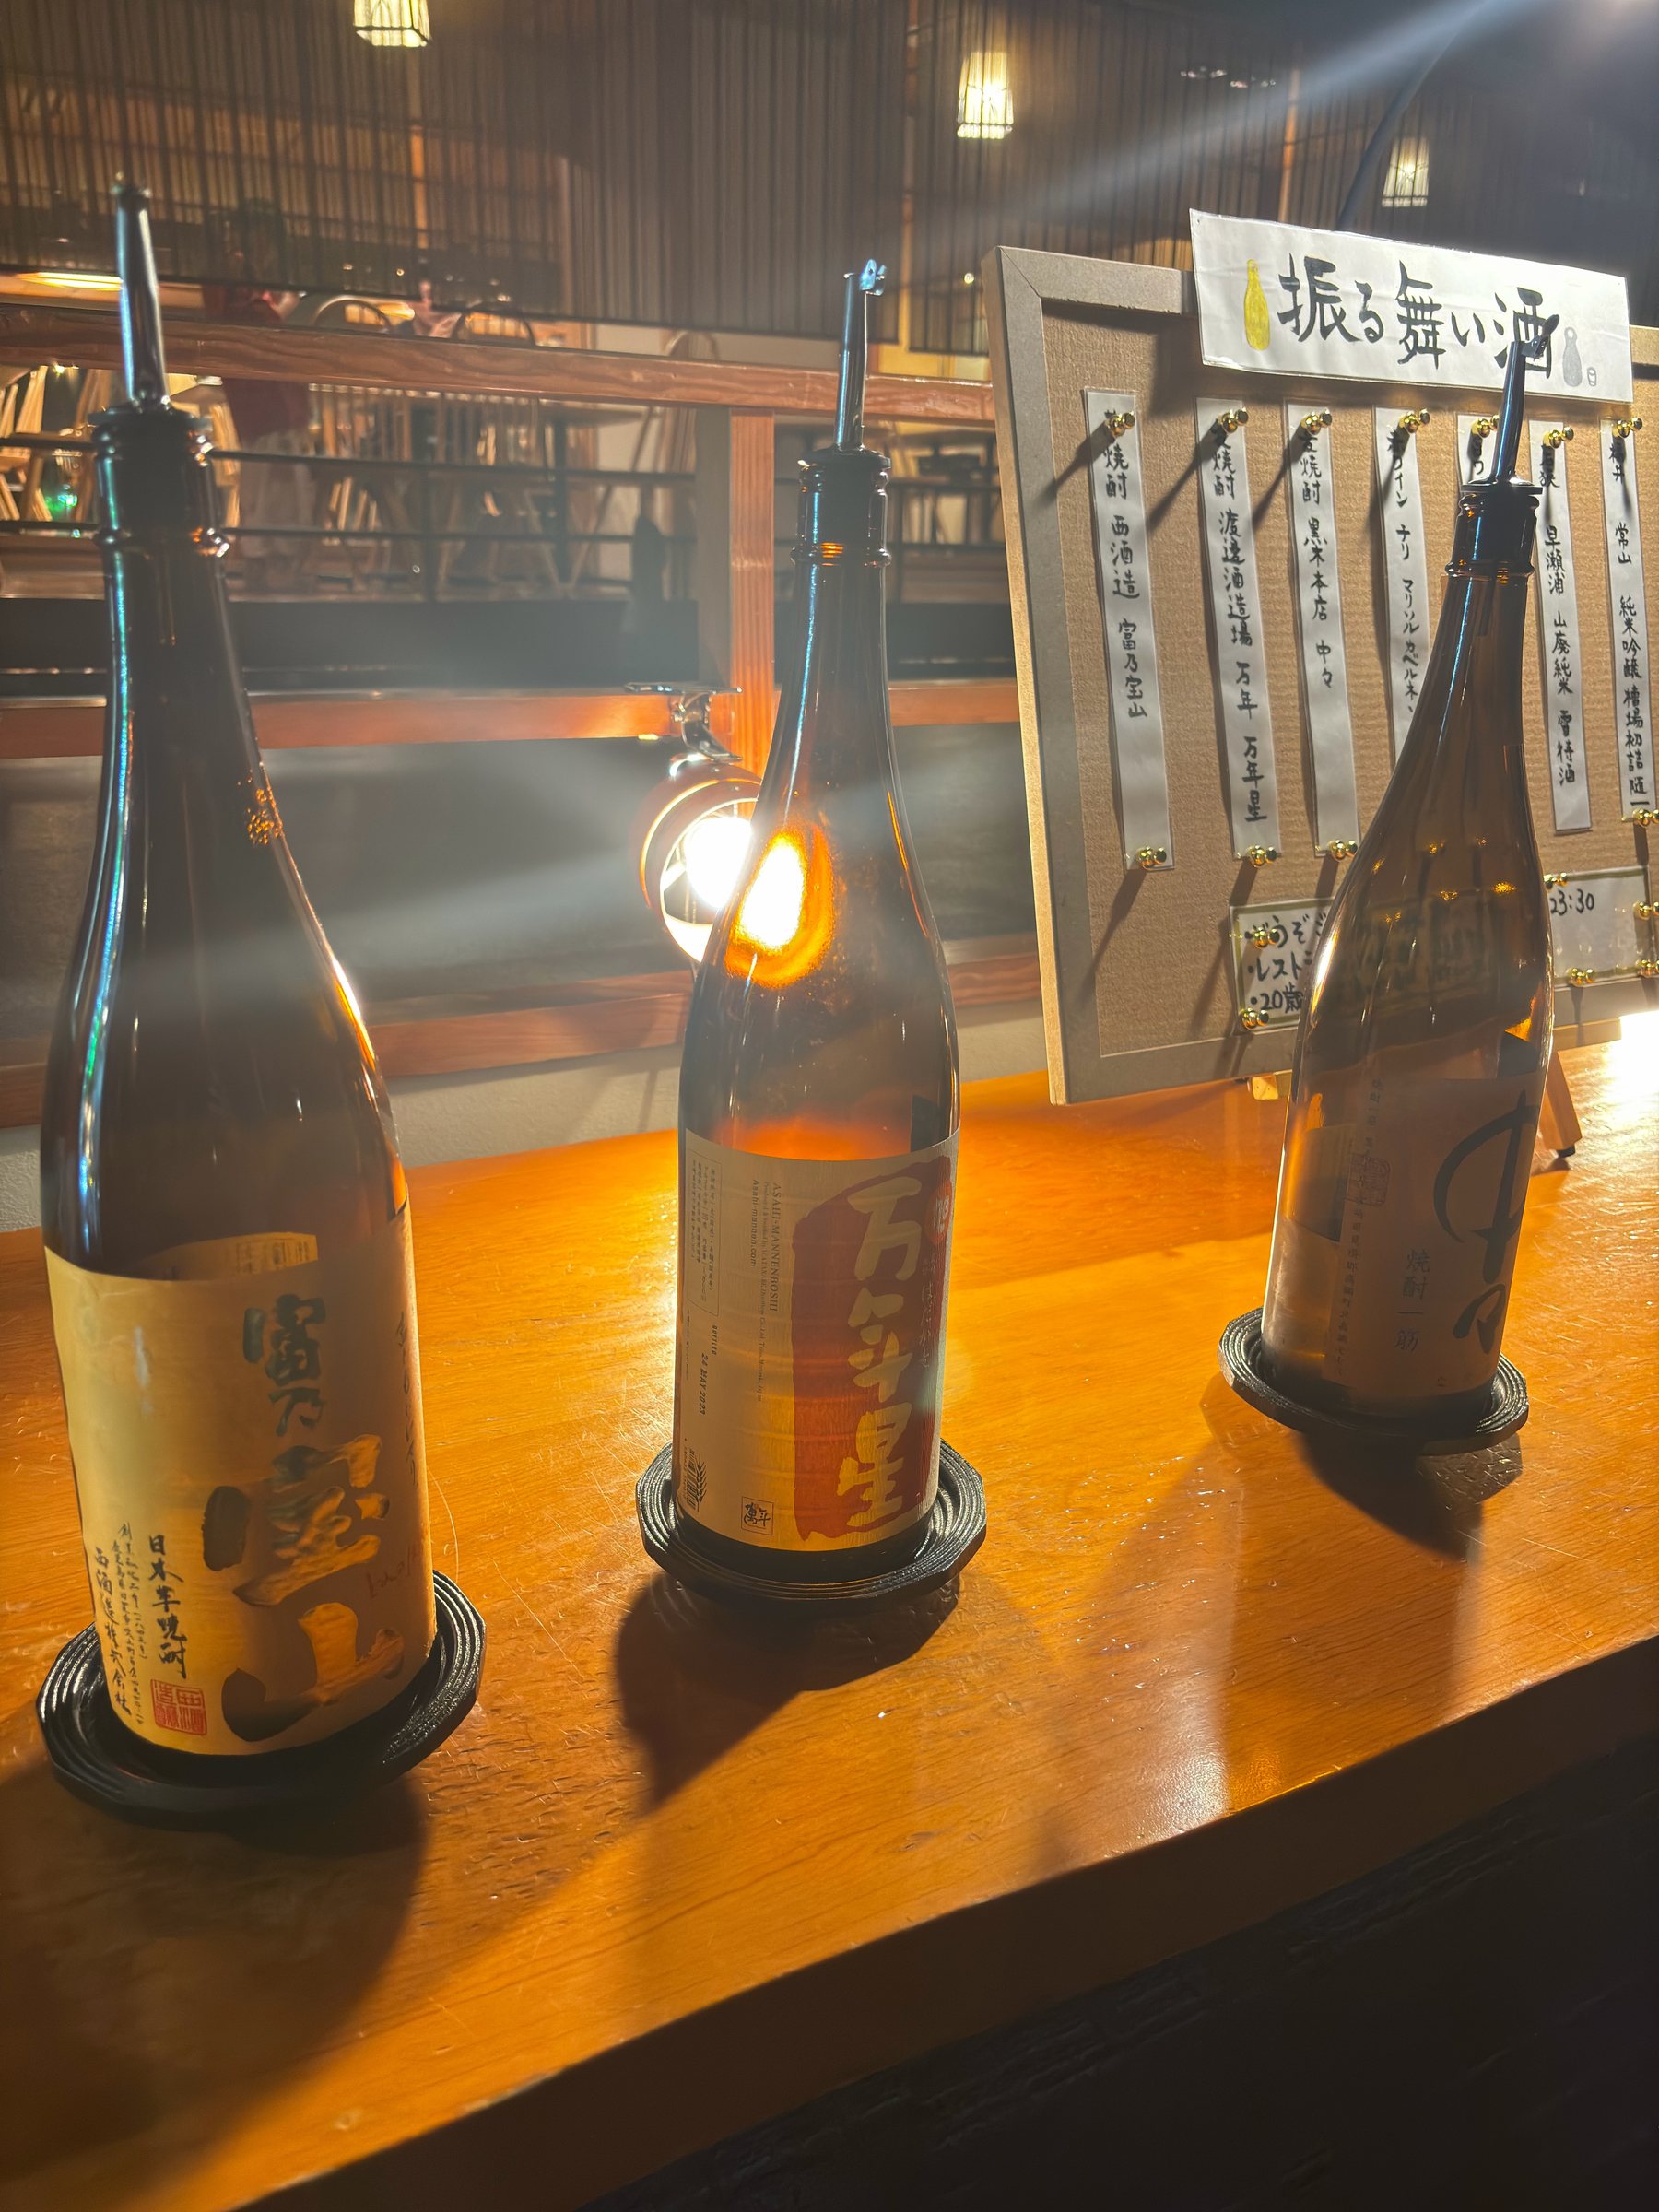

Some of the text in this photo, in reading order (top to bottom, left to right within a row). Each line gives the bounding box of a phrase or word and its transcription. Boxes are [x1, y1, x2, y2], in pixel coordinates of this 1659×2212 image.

[1277, 253, 1553, 379] 振る舞い酒
[1104, 410, 1148, 718] 焼酎 西酒造 富乃宝山
[1395, 524, 1410, 560] チリ
[1544, 525, 1566, 595] 早瀬浦
[1615, 522, 1632, 565] 常山
[1303, 516, 1328, 621] 黒木本店
[1316, 640, 1333, 688] 中々
[1236, 661, 1258, 720] 万年
[1550, 888, 1594, 916] 23:30
[750, 1179, 760, 1267] Asahi-mannen.com
[769, 1182, 782, 1312] ASAHI-MANNENBOSHI
[1394, 1248, 1430, 1352] 焼酎一筋
[698, 1390, 707, 1416] 2023
[700, 1368, 708, 1390] MAY
